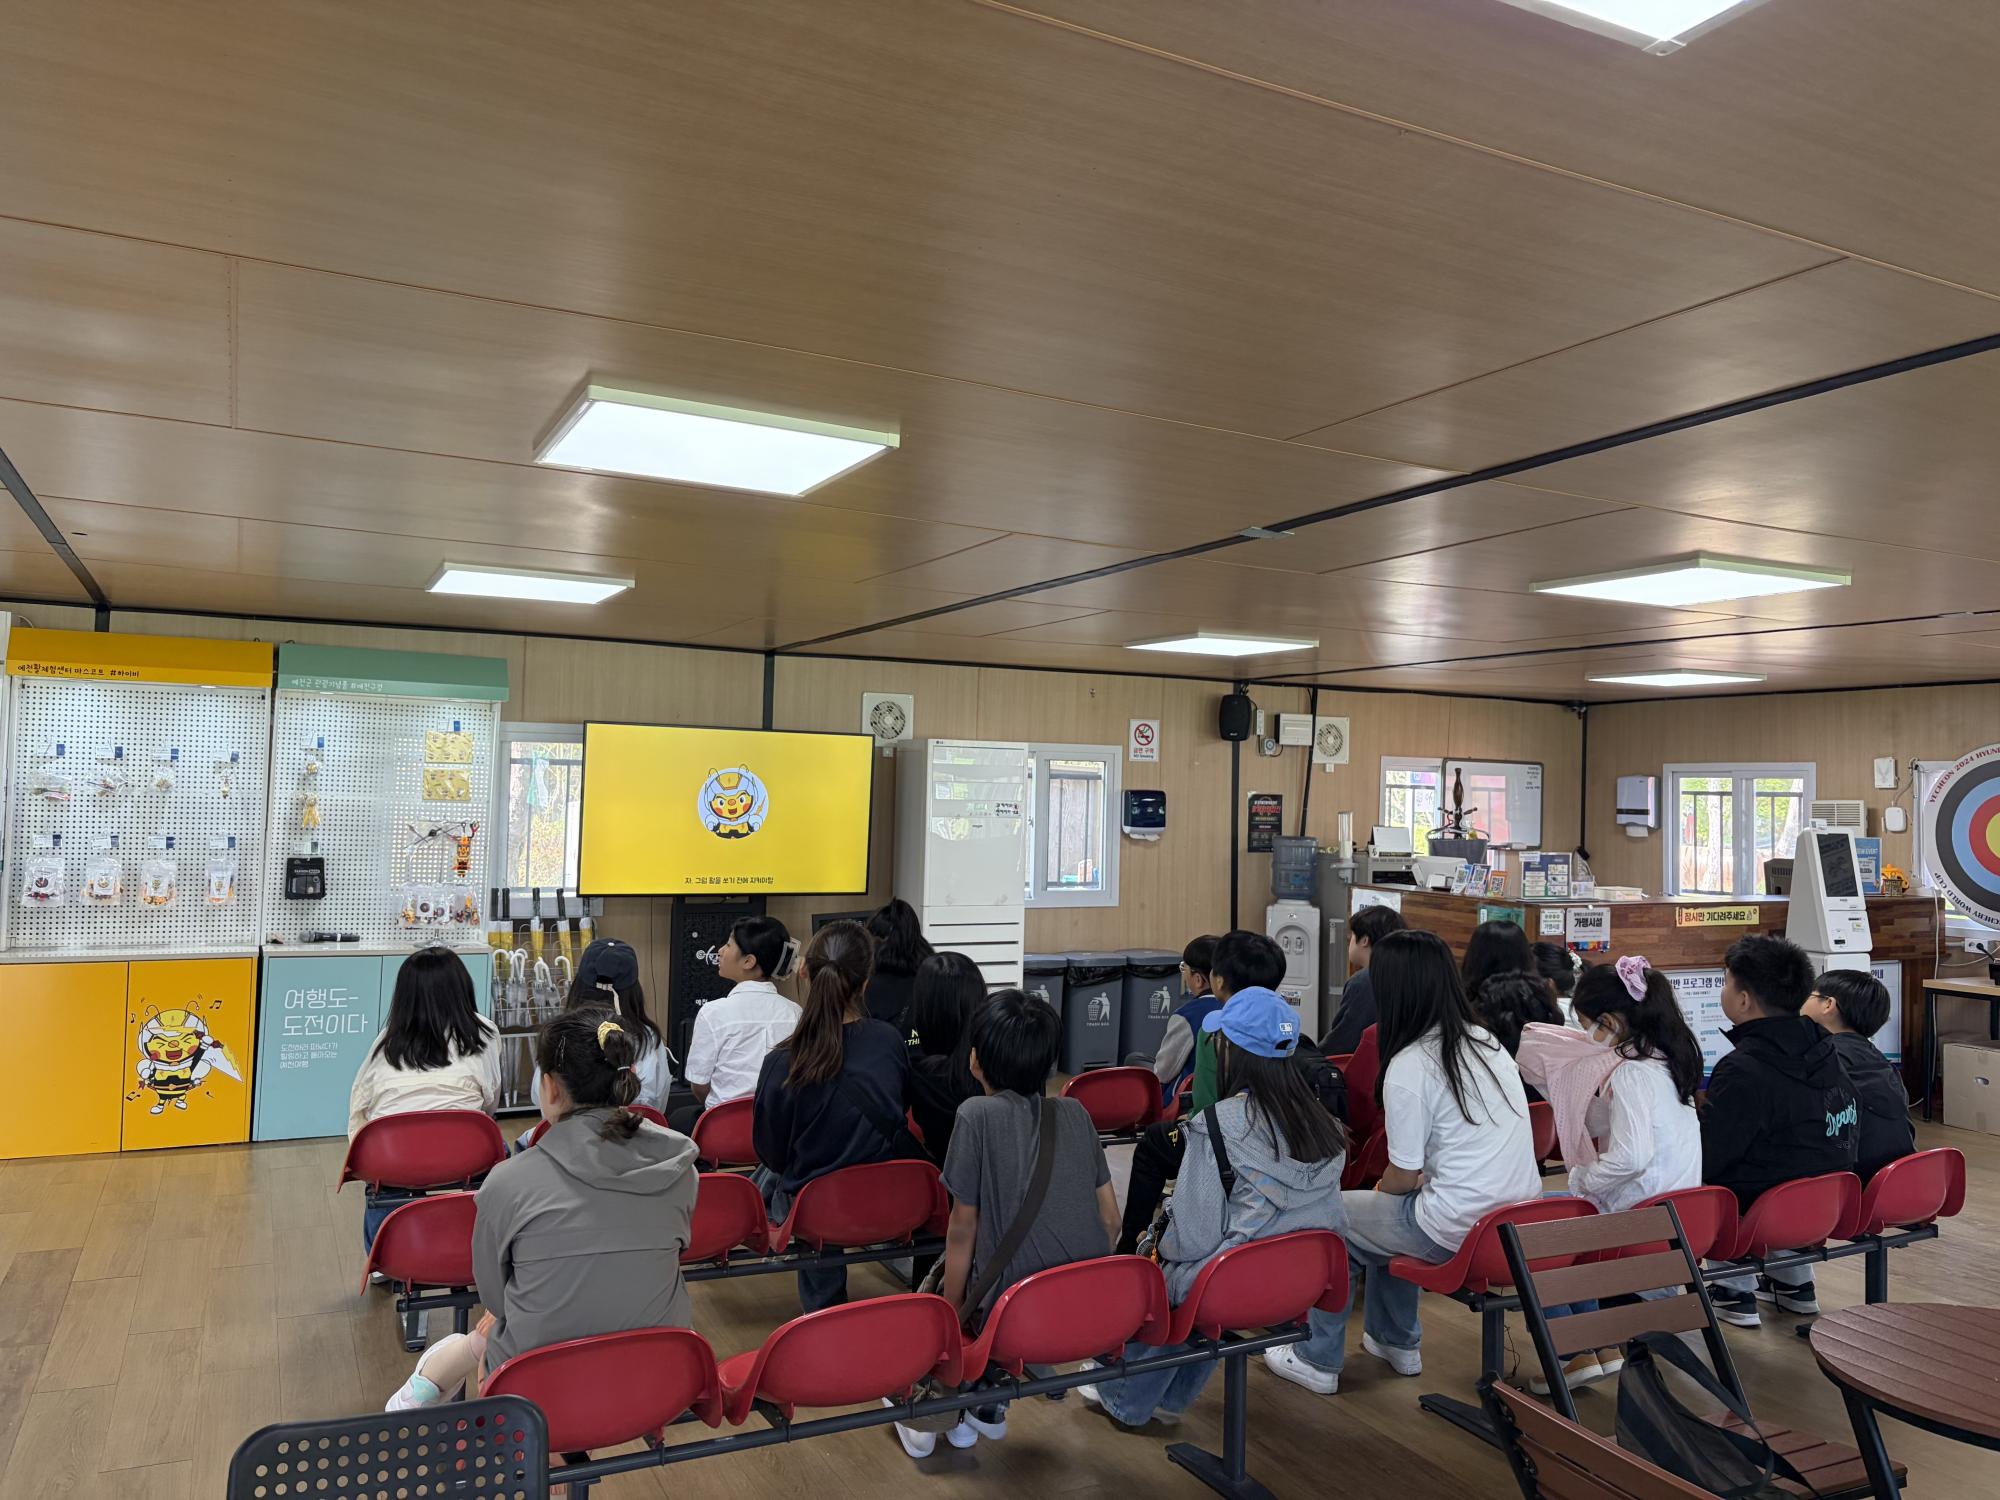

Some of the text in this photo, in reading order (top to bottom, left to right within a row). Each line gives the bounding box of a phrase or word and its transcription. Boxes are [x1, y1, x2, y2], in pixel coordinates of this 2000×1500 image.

[1928, 769, 1956, 804] YECHEON
[1954, 754, 1975, 772] 2024
[1934, 872, 2000, 926] CHERY WORLD CUP
[1574, 917, 1603, 928] 가맹시설
[1684, 911, 1746, 922] 잠시만 기다려주세요
[1670, 978, 1681, 990] 반
[1682, 976, 1713, 989] 프로그램
[281, 1013, 369, 1036] 도전이다
